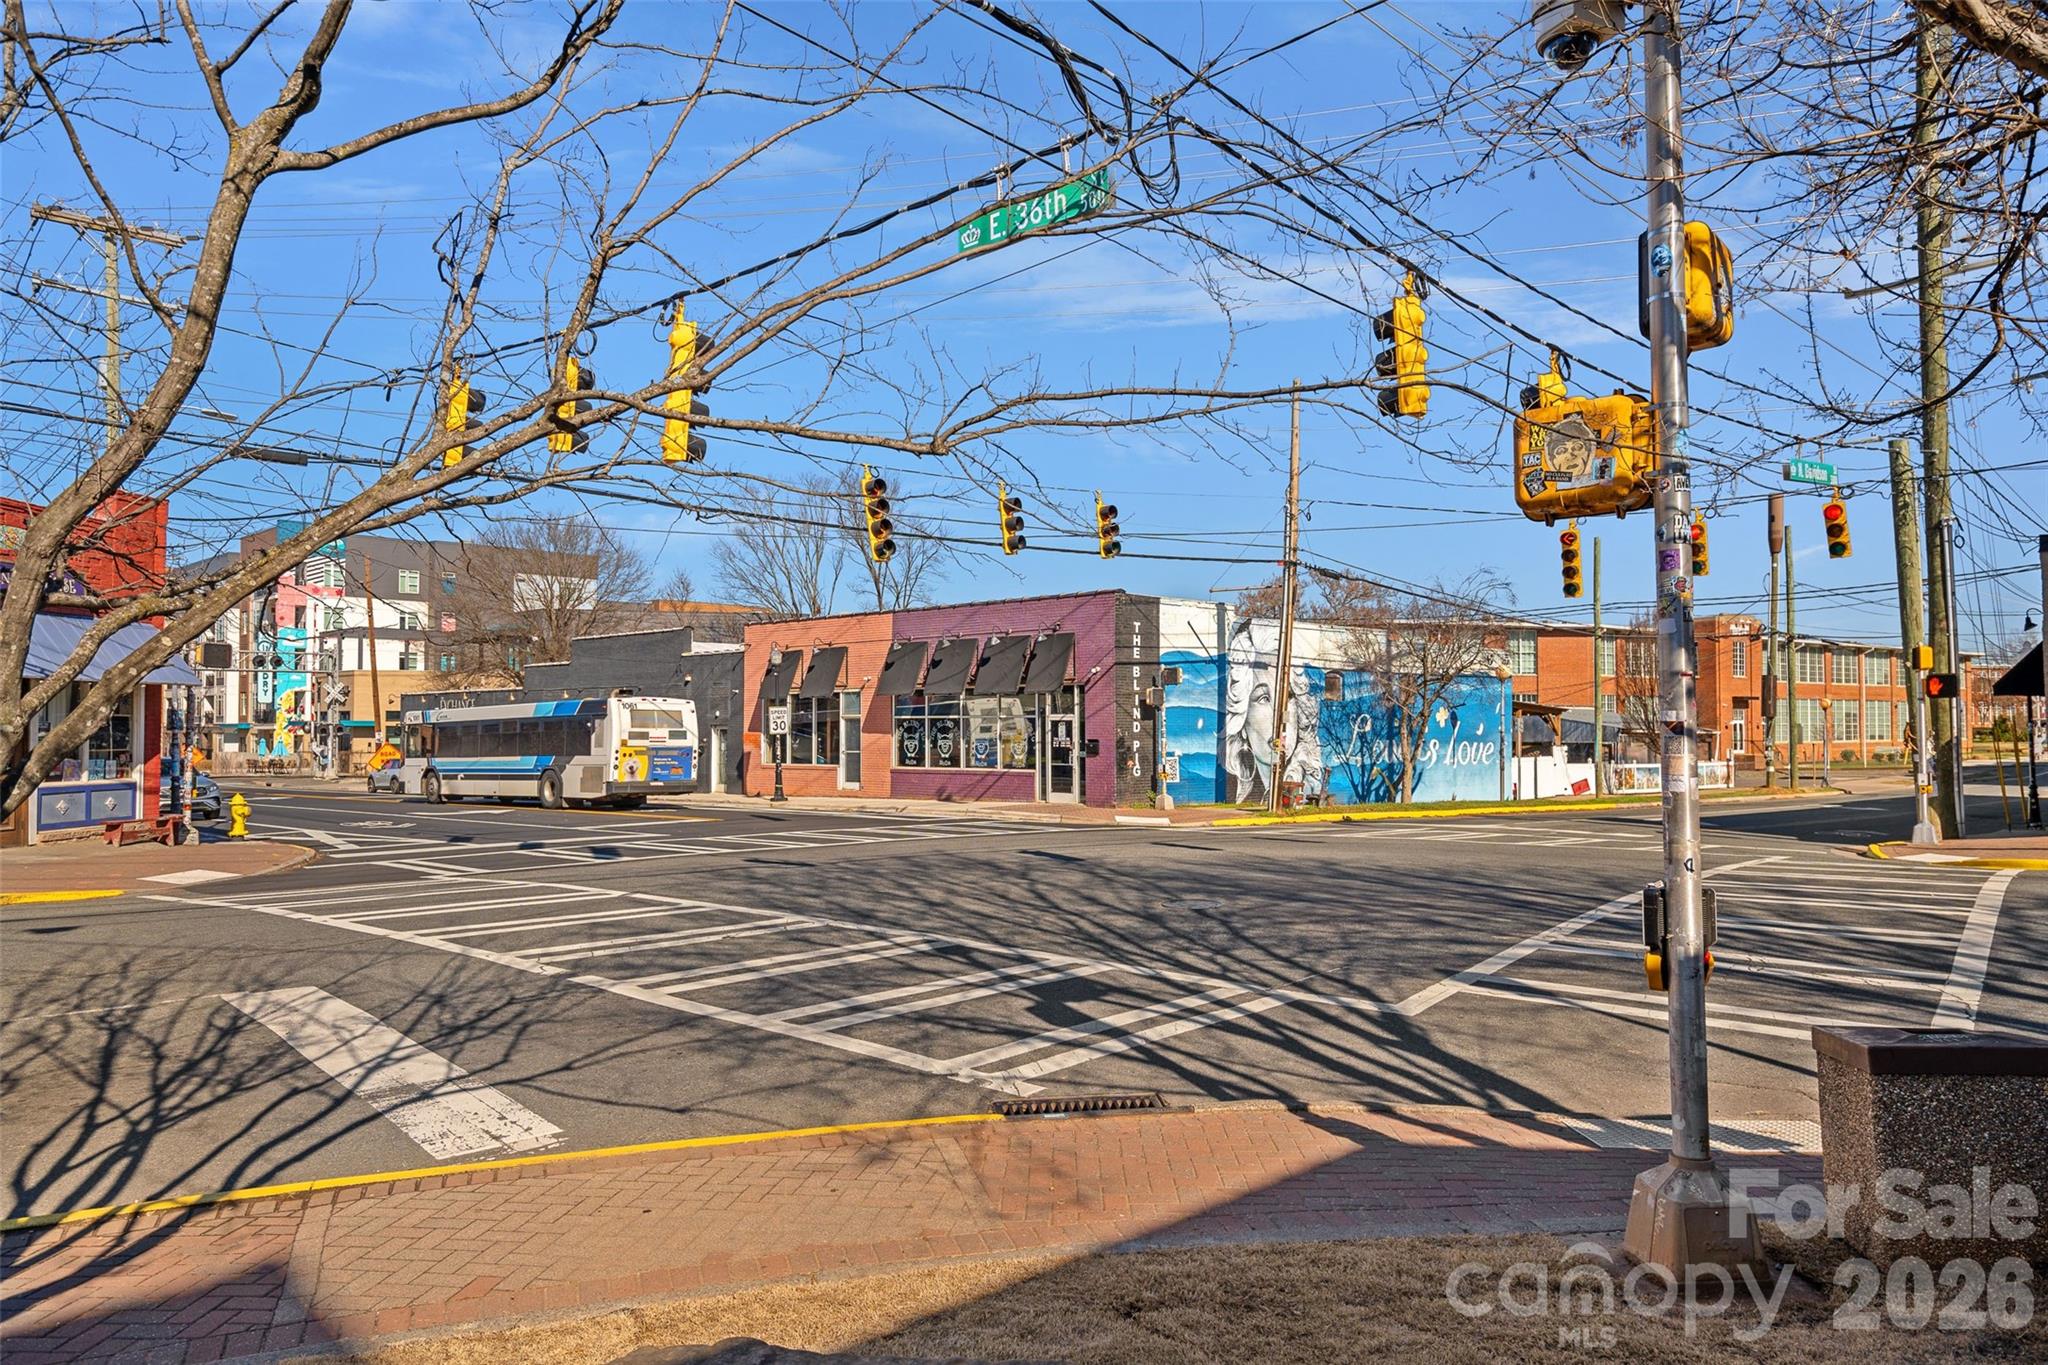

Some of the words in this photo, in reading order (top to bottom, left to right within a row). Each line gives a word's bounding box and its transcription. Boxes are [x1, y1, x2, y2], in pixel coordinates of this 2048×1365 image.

[989, 211, 1006, 241] E.
[1015, 190, 1067, 230] 36th
[1132, 621, 1141, 659] THE
[621, 702, 638, 710] 1061
[1132, 665, 1141, 732] BLIND
[772, 720, 787, 731] 30
[1132, 740, 1141, 777] PIG
